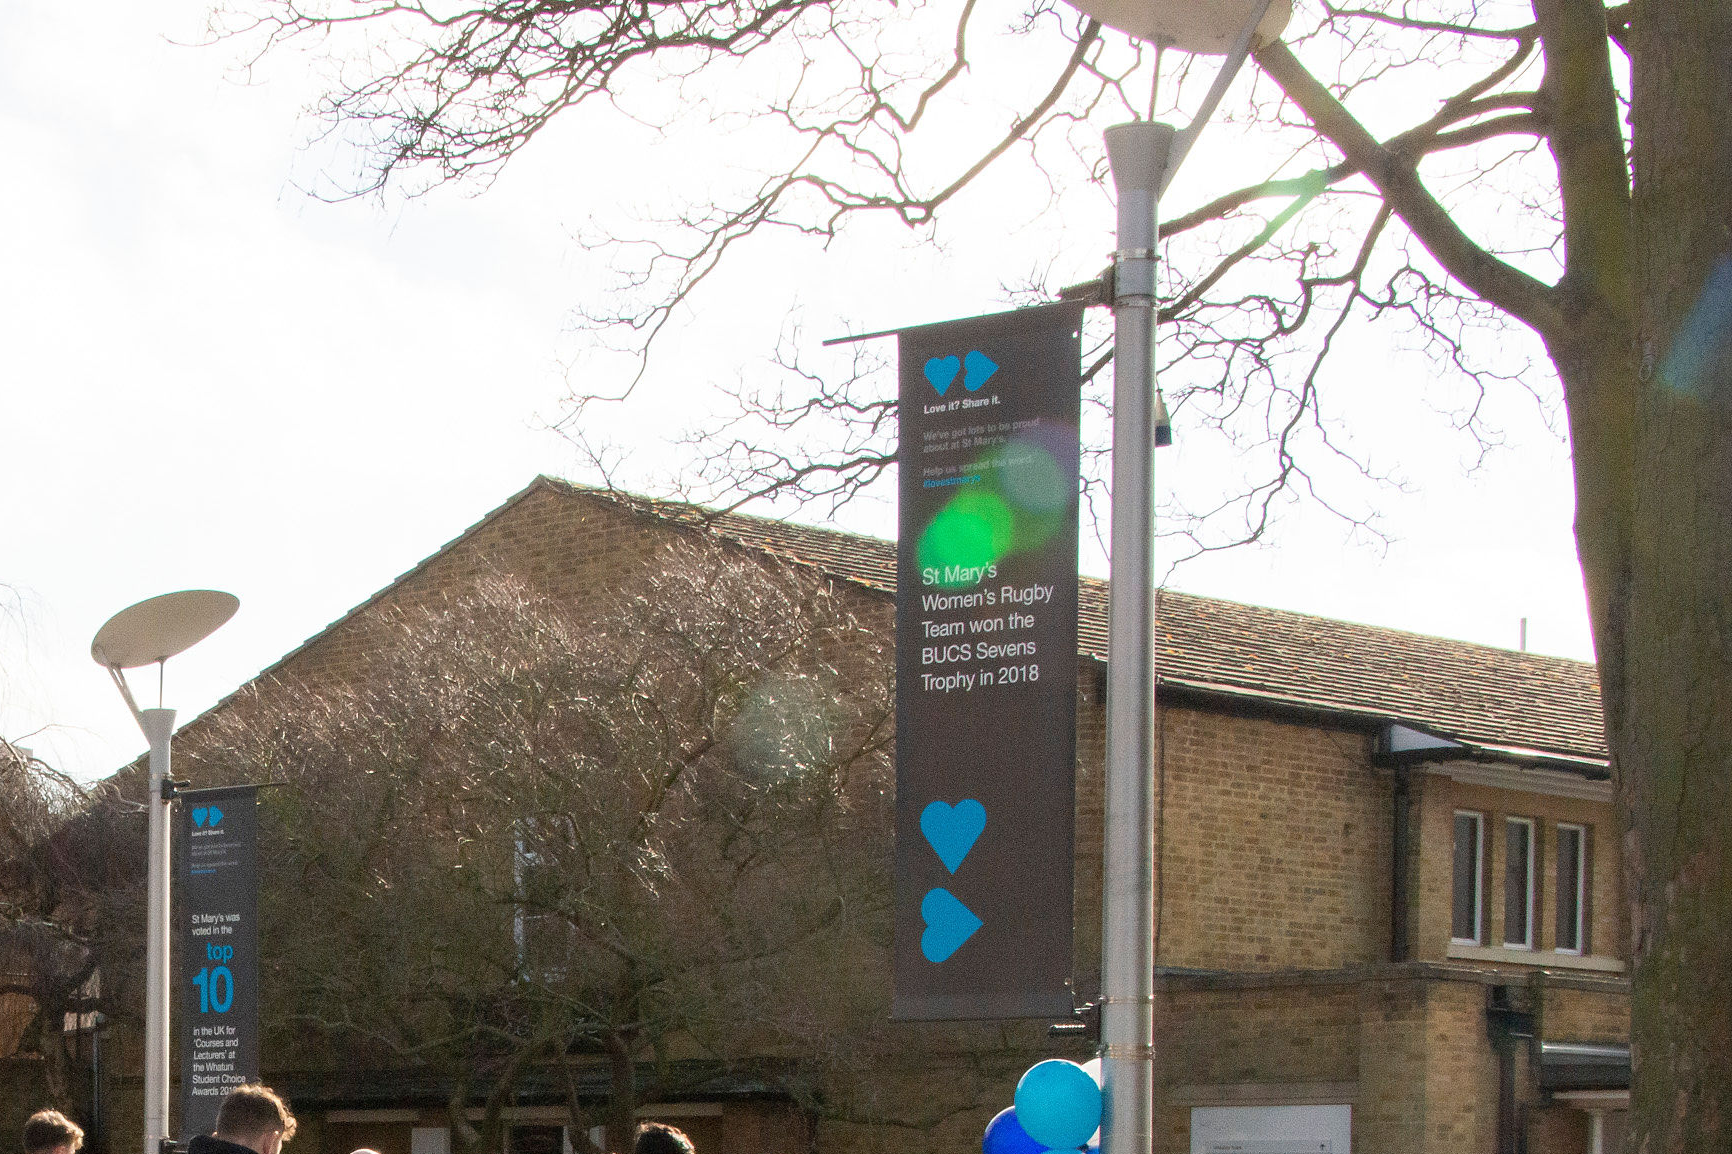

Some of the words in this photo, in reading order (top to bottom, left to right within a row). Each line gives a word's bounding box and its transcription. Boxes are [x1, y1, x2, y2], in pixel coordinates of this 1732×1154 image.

[924, 404, 946, 414] Love
[961, 397, 990, 409] Share
[1012, 417, 1040, 432] proud
[922, 567, 940, 586] St
[944, 562, 998, 584] Mary's
[922, 588, 996, 612] Women's
[1001, 584, 1054, 606] Rugby
[922, 621, 964, 638] Team
[970, 618, 1004, 634] won
[1008, 612, 1035, 630] the
[922, 644, 972, 665] BUCS
[976, 641, 1036, 660] Sevens
[921, 671, 976, 693] Trophy
[980, 669, 994, 686] in
[998, 664, 1039, 684] 2018
[192, 914, 200, 924] St
[201, 913, 224, 924] Mary's
[226, 912, 240, 922] was
[192, 926, 212, 936] voted
[212, 926, 220, 935] in
[221, 925, 232, 935] the
[206, 942, 234, 964] top
[192, 966, 234, 1014] 10
[194, 1027, 200, 1036] in
[201, 1026, 212, 1036] the
[214, 1026, 224, 1036] UK
[226, 1026, 236, 1035] for
[225, 1038, 238, 1047] and
[228, 1050, 236, 1059] at
[194, 1063, 204, 1072] the
[206, 1062, 234, 1072] Whatuni
[192, 1074, 220, 1084] Student
[222, 1074, 246, 1084] Choice
[192, 1086, 218, 1096] Awards
